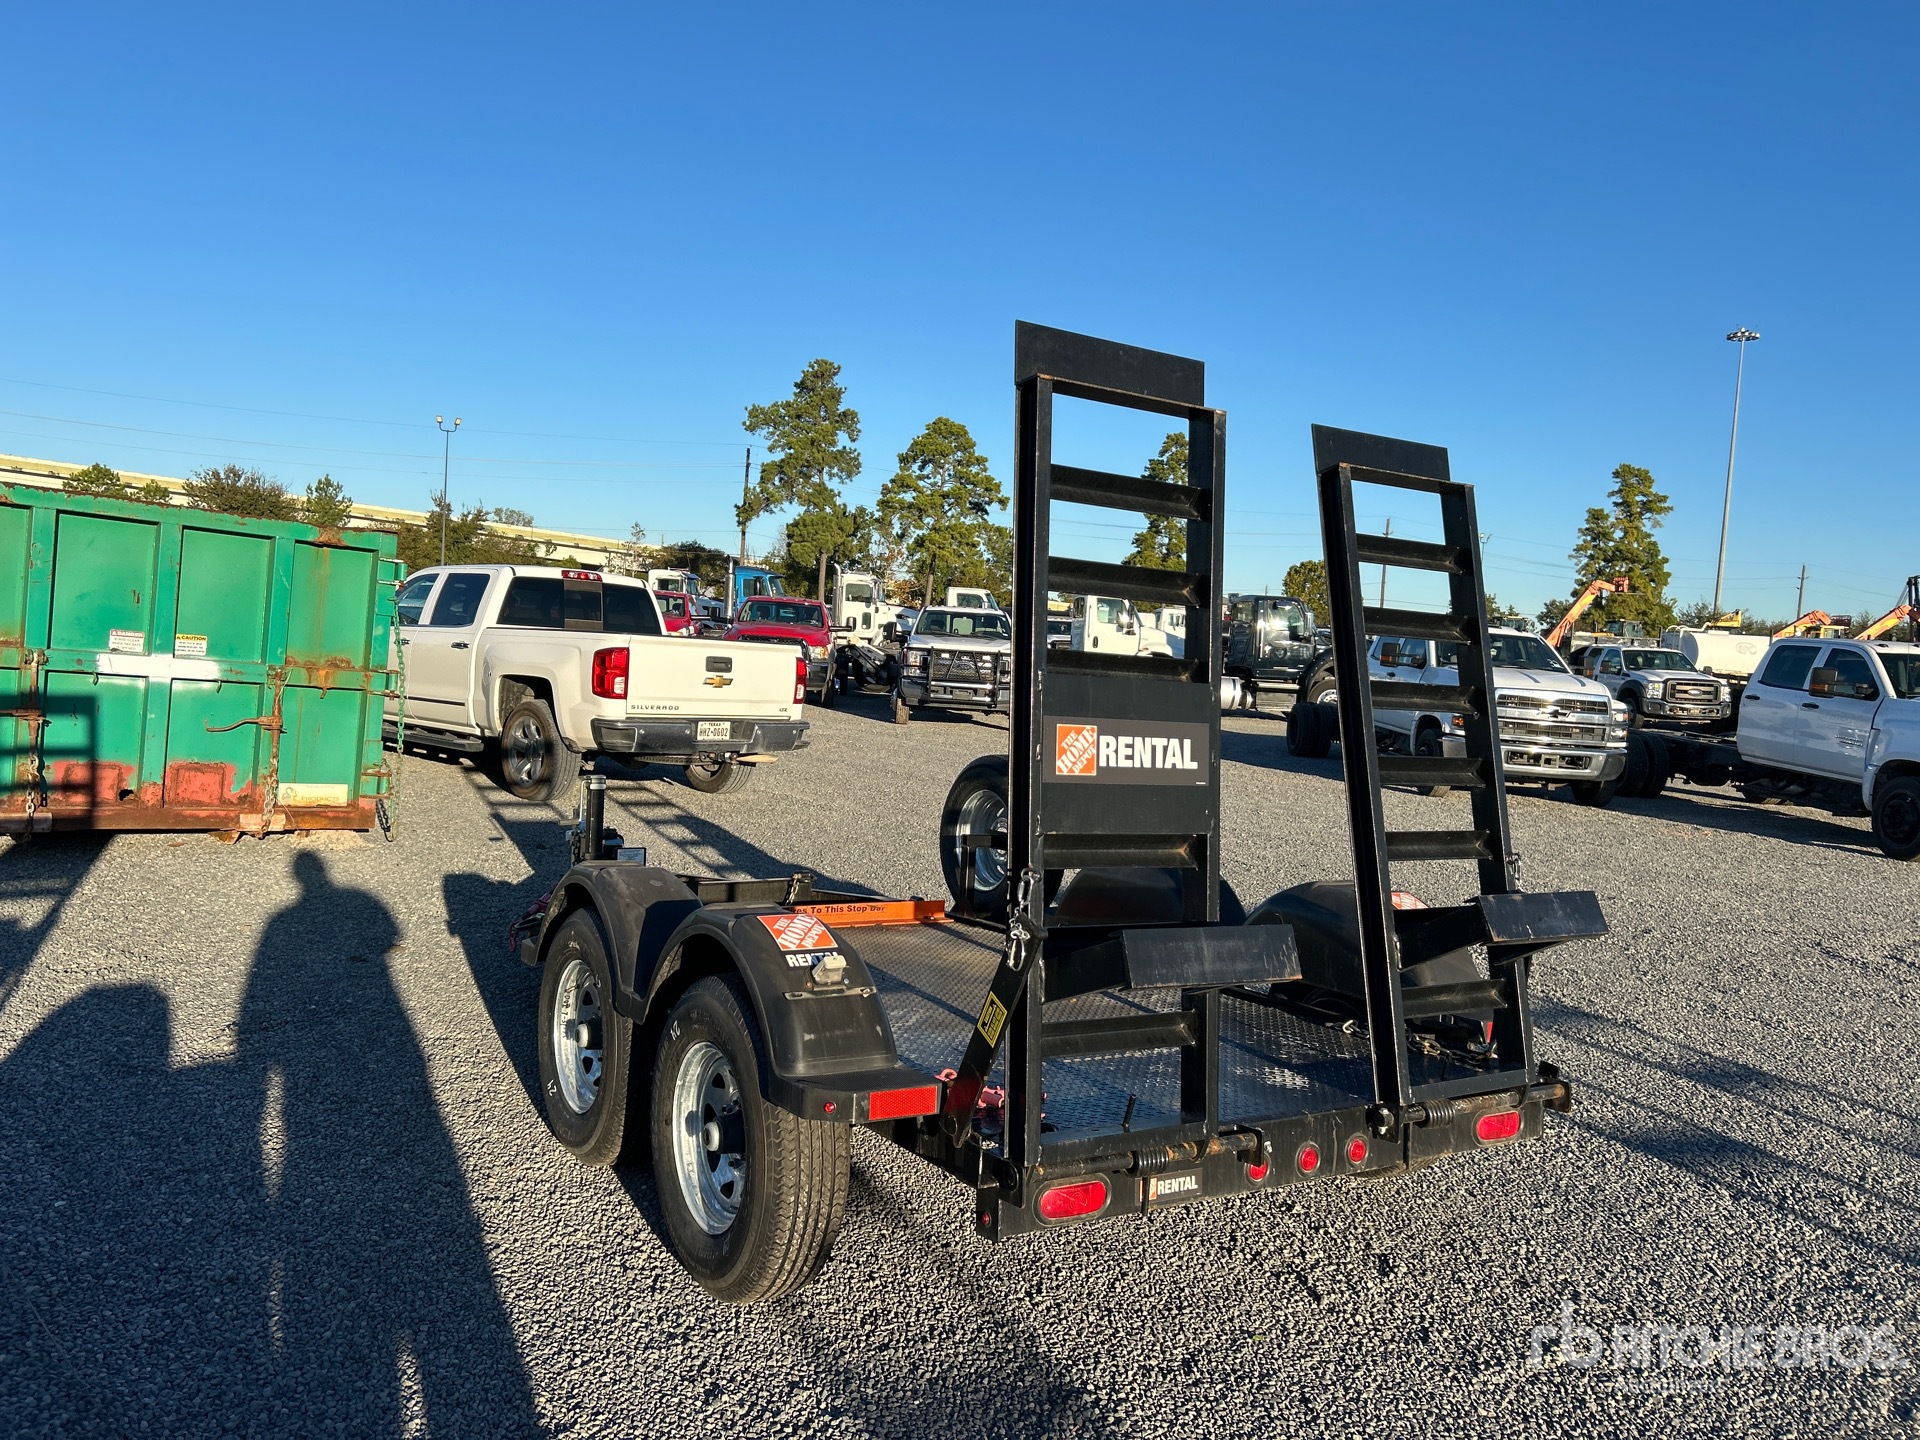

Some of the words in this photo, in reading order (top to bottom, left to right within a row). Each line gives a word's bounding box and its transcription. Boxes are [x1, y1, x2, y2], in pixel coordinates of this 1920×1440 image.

[1056, 725, 1096, 774] HOME
[1060, 730, 1079, 748] THE
[1099, 735, 1199, 769] RENTAL
[1071, 743, 1096, 774] DEPOT
[811, 906, 822, 914] To
[826, 904, 844, 913] This
[847, 904, 868, 913] Stop
[773, 916, 791, 931] THE
[778, 913, 818, 949] HOME
[801, 923, 826, 949] DEPOT
[1157, 1175, 1199, 1196] RENTAL
